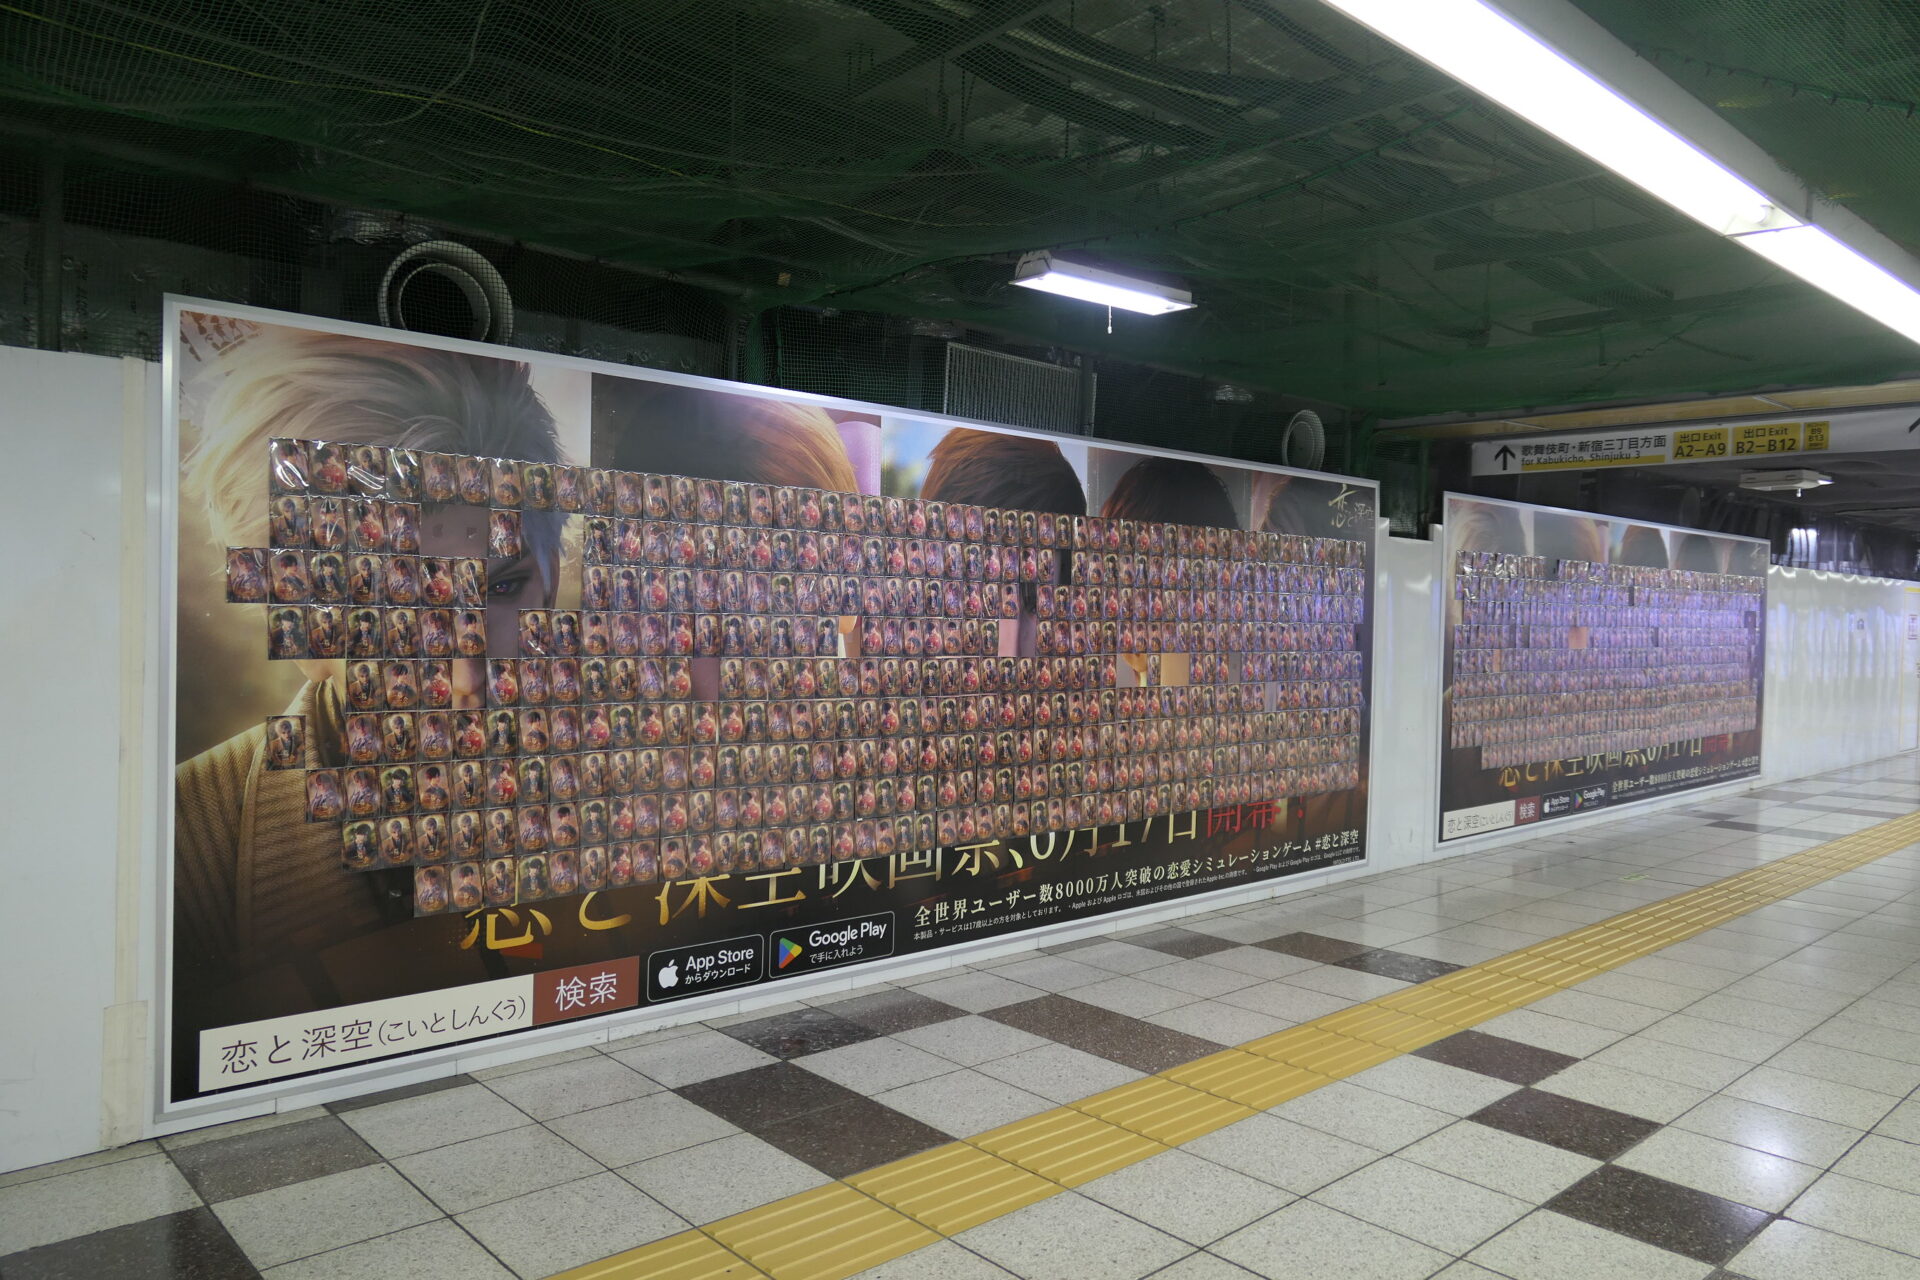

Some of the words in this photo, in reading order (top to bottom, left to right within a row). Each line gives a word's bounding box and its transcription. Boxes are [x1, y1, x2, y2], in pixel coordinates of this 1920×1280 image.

[1679, 433, 1700, 444] 出口
[1703, 432, 1721, 441] Exit
[1744, 427, 1766, 439] 出口
[1769, 427, 1788, 436] Exit
[1521, 435, 1667, 456] 歌舞伎町・新宿三丁目方面
[1521, 457, 1534, 466] for
[1590, 451, 1631, 462] Shinjuku
[1635, 450, 1641, 459] 3
[914, 840, 1312, 928] 全世界ユーザー数8000万人突破の恋愛シミュレーションゲーム
[809, 924, 857, 948] Google
[860, 920, 887, 941] Play
[685, 954, 715, 974] App
[718, 947, 754, 967] Store
[809, 944, 864, 965] で手に入れよう
[685, 963, 751, 985] からダウンロード
[555, 971, 618, 1012] 検索
